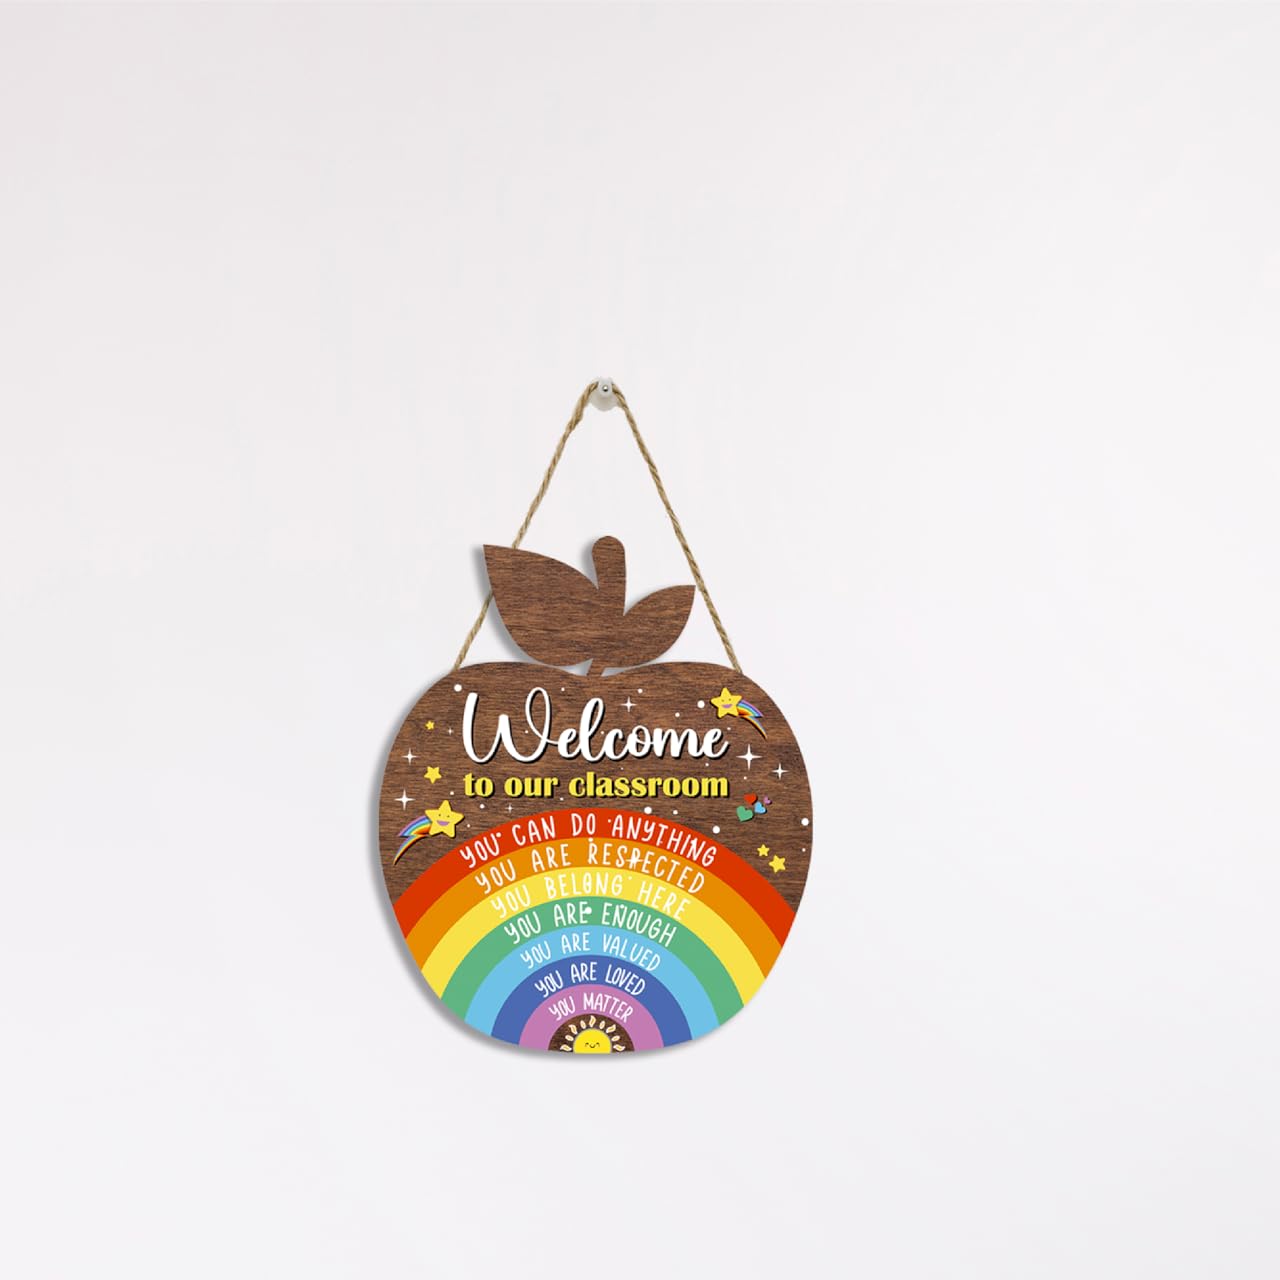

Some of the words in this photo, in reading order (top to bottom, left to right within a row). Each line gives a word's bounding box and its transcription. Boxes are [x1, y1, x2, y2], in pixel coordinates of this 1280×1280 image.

[462, 686, 729, 763] Welcome
[463, 773, 494, 797] to
[504, 777, 559, 797] our
[569, 771, 729, 798] classroom
[460, 832, 501, 868] YOU
[512, 815, 555, 846] CAN
[572, 813, 596, 836] DO
[611, 814, 717, 867] ANYTHING
[475, 864, 516, 894] YOU
[531, 843, 571, 868] ARE
[588, 842, 706, 894] RESPECTED
[491, 885, 531, 918] YOU
[545, 874, 623, 899] BELONG
[639, 881, 691, 921] HERE
[504, 911, 541, 944] YOU
[553, 900, 588, 923] ARE
[601, 901, 677, 947] ENOUGH
[520, 946, 551, 969] YOU
[560, 932, 590, 953] ARE
[602, 932, 661, 972] VALUED
[534, 969, 563, 998] YOU
[570, 962, 597, 982] ARE
[605, 962, 646, 996] LOVED
[548, 997, 576, 1020] YOU
[583, 991, 633, 1023] MATTER
